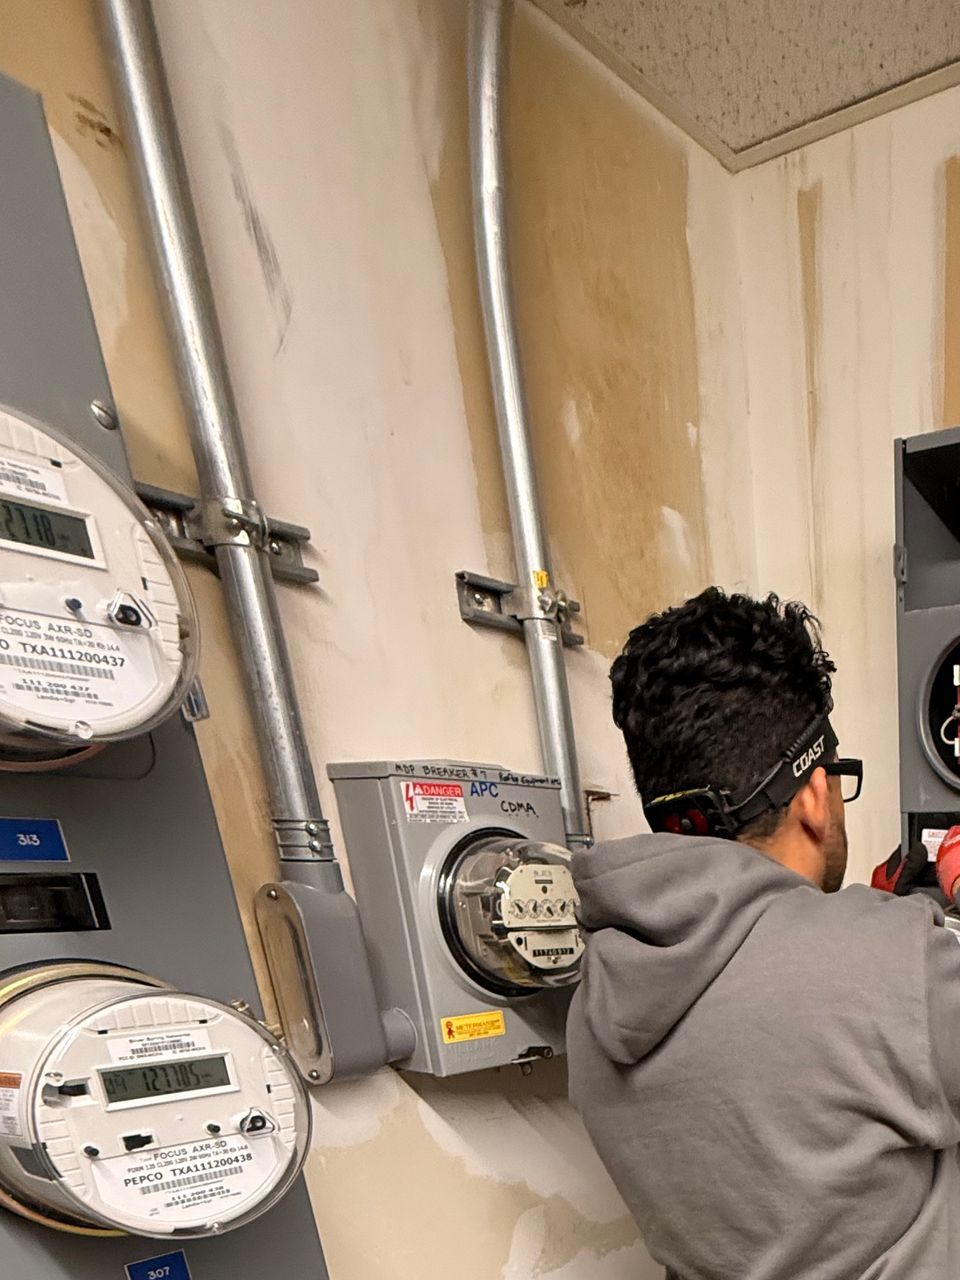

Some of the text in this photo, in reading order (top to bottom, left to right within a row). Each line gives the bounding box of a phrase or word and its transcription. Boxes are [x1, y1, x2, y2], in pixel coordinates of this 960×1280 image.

[18, 641, 125, 667] TXA111200437
[792, 734, 825, 778] COAST
[422, 765, 470, 778] BREAKER
[423, 784, 462, 796] DANGER
[470, 782, 499, 798] APC
[500, 800, 537, 816] CDMA
[17, 834, 40, 846] 313
[153, 1140, 227, 1160] FOCUS AXR-SD
[123, 1152, 253, 1187] PEPCO TXA111200438
[147, 1266, 170, 1280] 307
